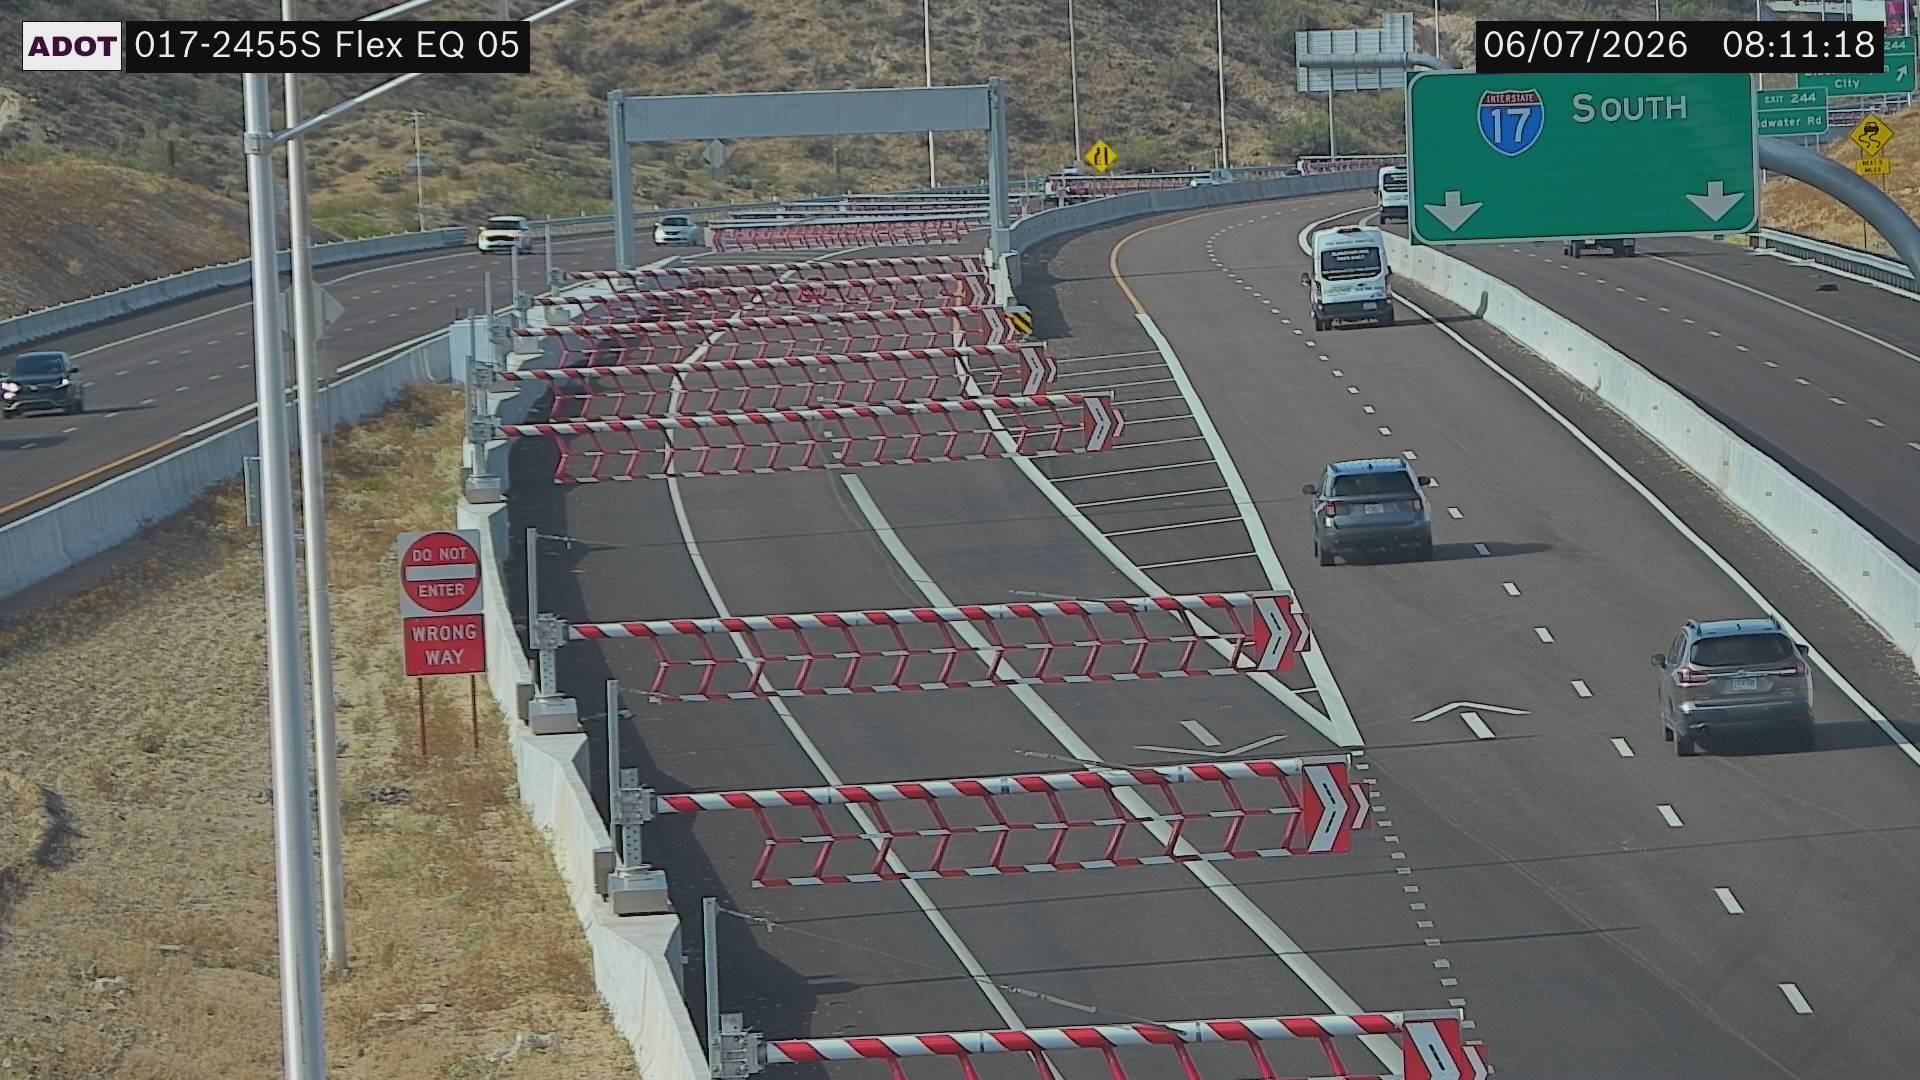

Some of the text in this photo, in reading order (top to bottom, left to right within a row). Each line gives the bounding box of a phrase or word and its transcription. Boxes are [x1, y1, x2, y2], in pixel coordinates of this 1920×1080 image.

[1835, 78, 1860, 89] City
[1486, 93, 1534, 104] INTERSTATE
[1764, 92, 1817, 104] EXIT 244
[1572, 93, 1687, 123] SOUTH
[1491, 108, 1531, 143] 17
[1807, 115, 1822, 126] Rd
[412, 547, 467, 562] DO NOT
[418, 583, 465, 598] ENTER
[412, 624, 477, 642] WRONG
[426, 649, 464, 665] WAY
